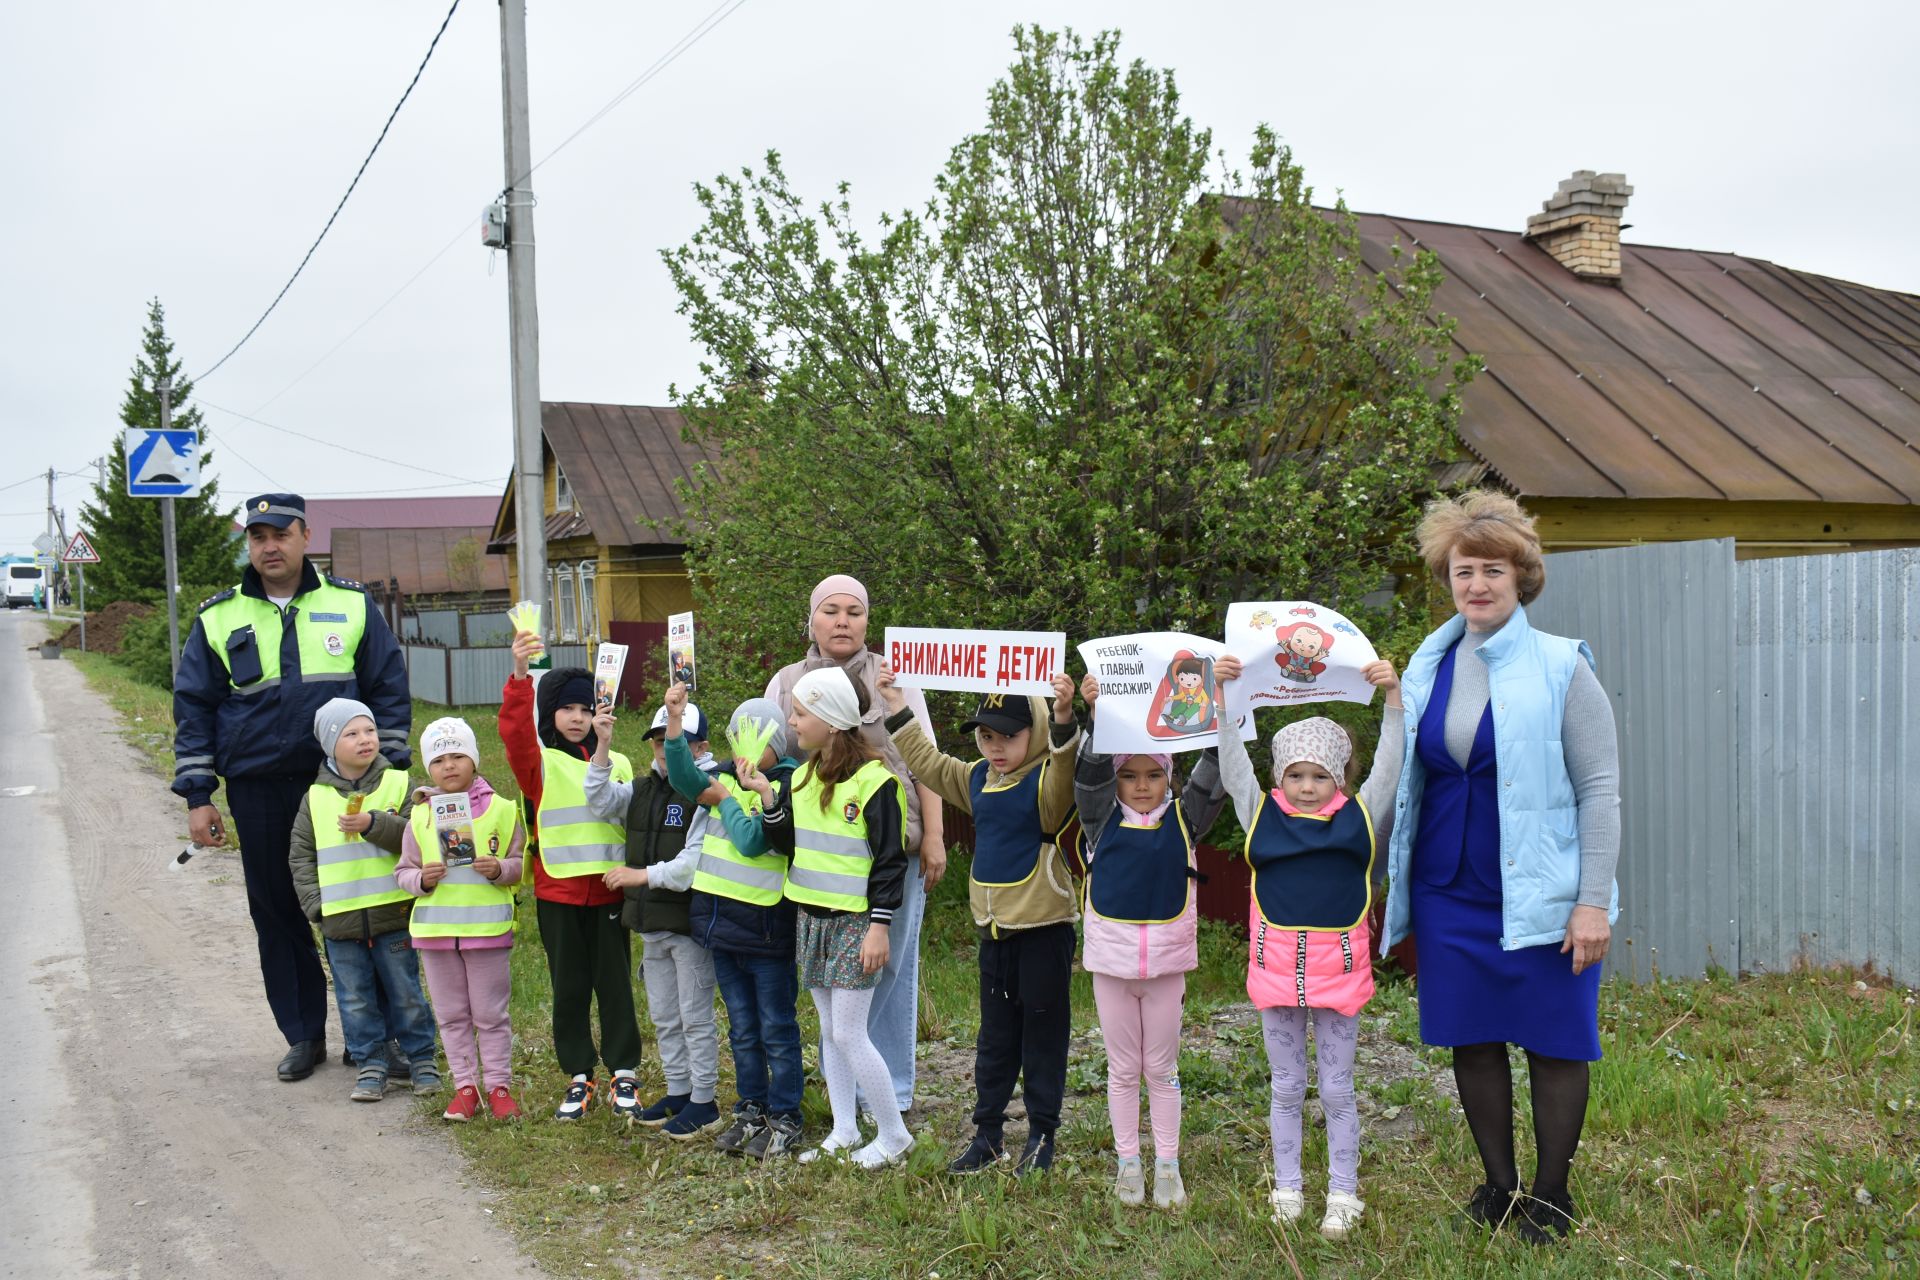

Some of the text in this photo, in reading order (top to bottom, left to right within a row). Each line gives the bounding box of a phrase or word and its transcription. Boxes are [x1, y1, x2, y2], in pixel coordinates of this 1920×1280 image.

[1096, 644, 1143, 658] РЕБЕНОК-
[891, 641, 1055, 687] ВНИМАНИЕ ДЕТИ!
[1099, 660, 1145, 676] ГЛАВНЫЙ
[1099, 682, 1153, 696] ПАССАЖИР!
[664, 804, 683, 827] R
[1298, 932, 1306, 953] LOVE
[1341, 934, 1351, 955] LOVE
[1297, 954, 1305, 974] LOVE
[1298, 995, 1306, 1007] LO
